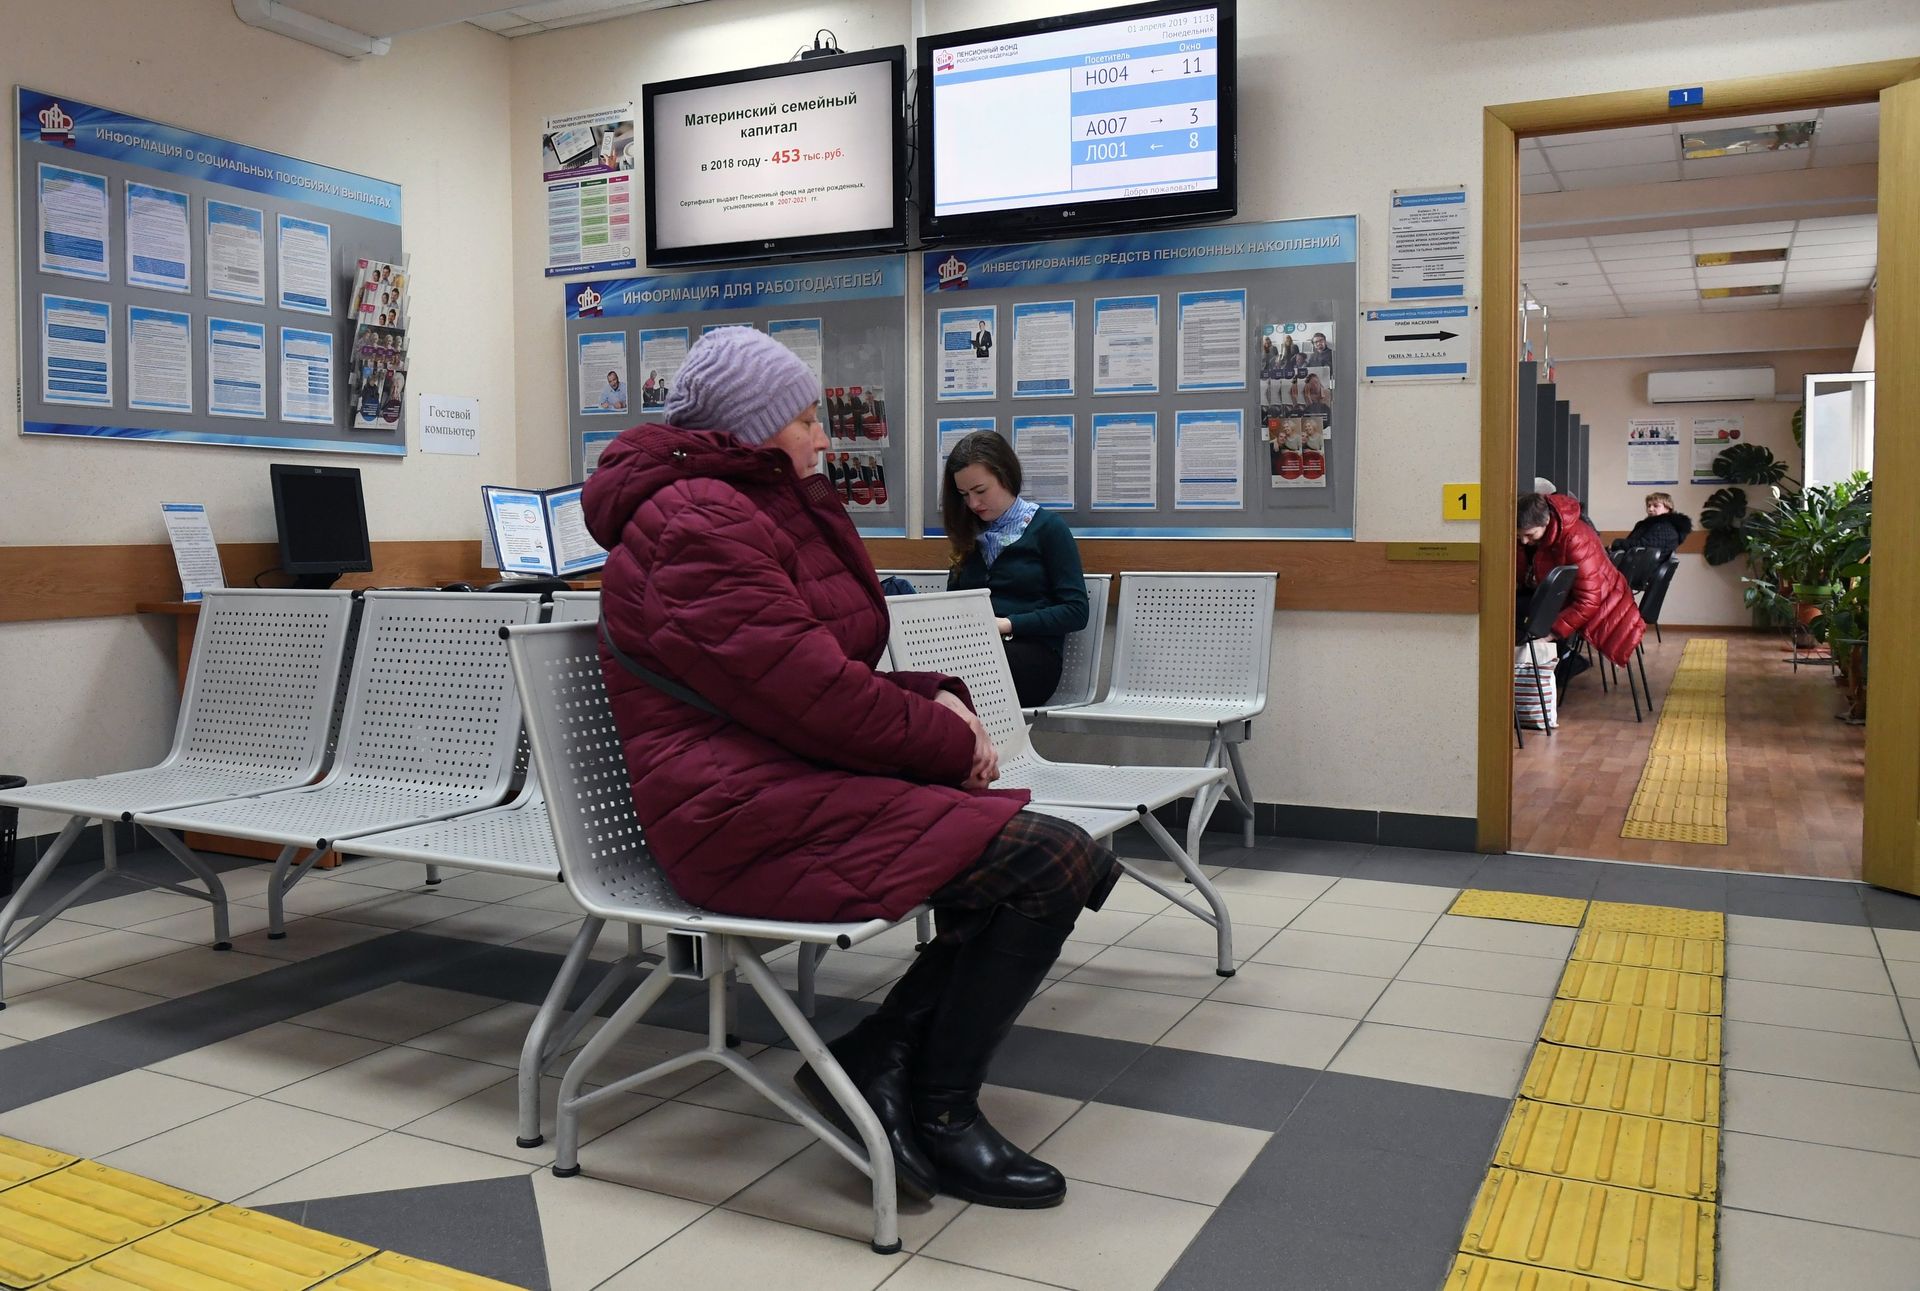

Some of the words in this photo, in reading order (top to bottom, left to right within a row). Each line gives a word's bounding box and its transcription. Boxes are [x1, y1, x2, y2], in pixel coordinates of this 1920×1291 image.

[1127, 25, 1137, 34] 01
[1139, 22, 1166, 33] апреля
[1168, 18, 1188, 28] 2019
[1193, 14, 1215, 24] 11:18
[1162, 27, 1214, 39] Понедельник
[956, 46, 998, 58] ПЕНСИОННЫЙ
[999, 44, 1018, 52] ФОНД
[1179, 42, 1201, 52] Окно
[1085, 52, 1130, 64] Посетитель
[1182, 57, 1202, 75] 11
[1682, 91, 1688, 102] 1
[685, 102, 777, 127] Материнский
[781, 92, 857, 114] семейный
[1189, 107, 1199, 124] 3
[740, 122, 798, 138] капитал
[1085, 141, 1128, 161] Л001
[1189, 132, 1199, 149] 8
[96, 127, 183, 157] ИНФОРМАЦИЯ
[185, 149, 194, 161] О
[197, 152, 274, 180] СОЦИАЛЬНЫХ
[276, 171, 331, 194] ПОСОБИЯХ
[332, 186, 341, 197] И
[342, 187, 392, 209] ВЫПЛАТАХ
[701, 163, 708, 172] в
[710, 158, 734, 171] 2018
[737, 156, 761, 168] году
[771, 148, 801, 164] 453
[802, 148, 845, 162] тыс.руб.
[680, 198, 715, 208] Сертификат
[716, 196, 739, 204] выдает
[739, 191, 778, 201] Пенсионный
[779, 189, 797, 197] фонд
[807, 186, 825, 194] детей
[1123, 187, 1149, 198] Добро
[1150, 182, 1198, 195] пожаловать!
[777, 196, 807, 206] 2007-2021
[981, 255, 1091, 274] ИНВЕСТИРОВАНИЕ
[1094, 250, 1150, 265] СРЕДСТВ
[1154, 241, 1245, 260] ПЕНСИОННЫХ
[1249, 233, 1341, 254] НАКОПЛЕНИЙ
[623, 284, 720, 305] ИНФОРМАЦИЯ
[724, 283, 752, 300] ДЛЯ
[756, 269, 883, 295] РАБОТОДАТЕЛЕЙ
[429, 405, 471, 420] Гостевой
[425, 425, 476, 440] компьютер
[1458, 493, 1467, 511] 1
